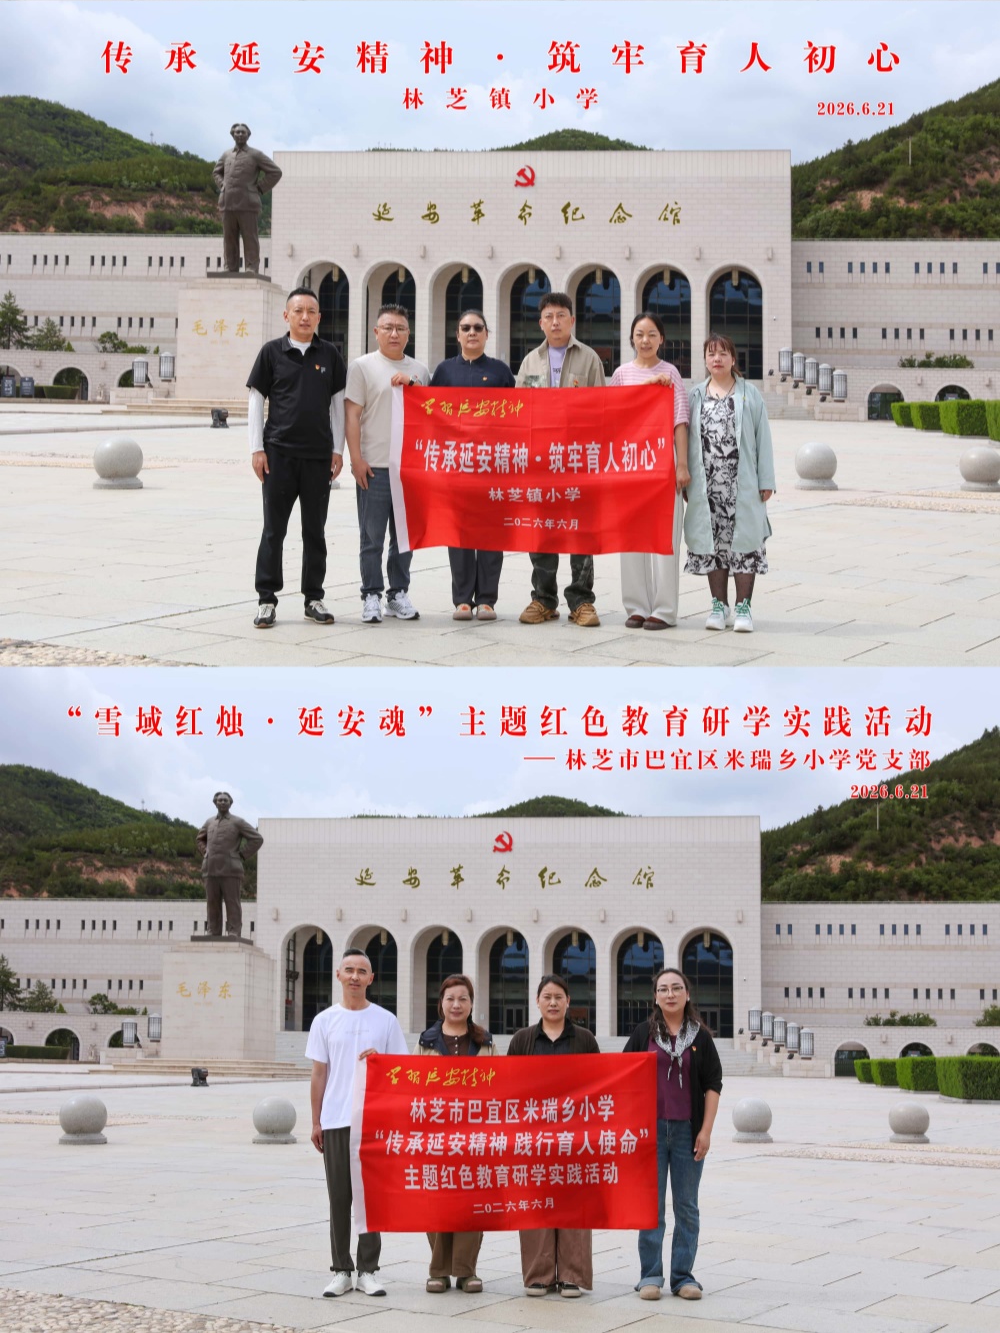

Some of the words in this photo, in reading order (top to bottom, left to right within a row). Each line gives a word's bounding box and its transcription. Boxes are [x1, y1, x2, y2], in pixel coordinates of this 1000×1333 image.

[371, 200, 682, 226] 延安革命纪念馆
[192, 318, 249, 337] 毛泽东
[488, 487, 581, 503] 林芝镇小学
[355, 865, 655, 889] 延安革命纪念馆
[176, 981, 232, 999] 毛泽东
[409, 1094, 615, 1124] 林芝市巴宜区米瑞乡小学
[404, 1162, 619, 1191] 主题红色教育研学实践活动
